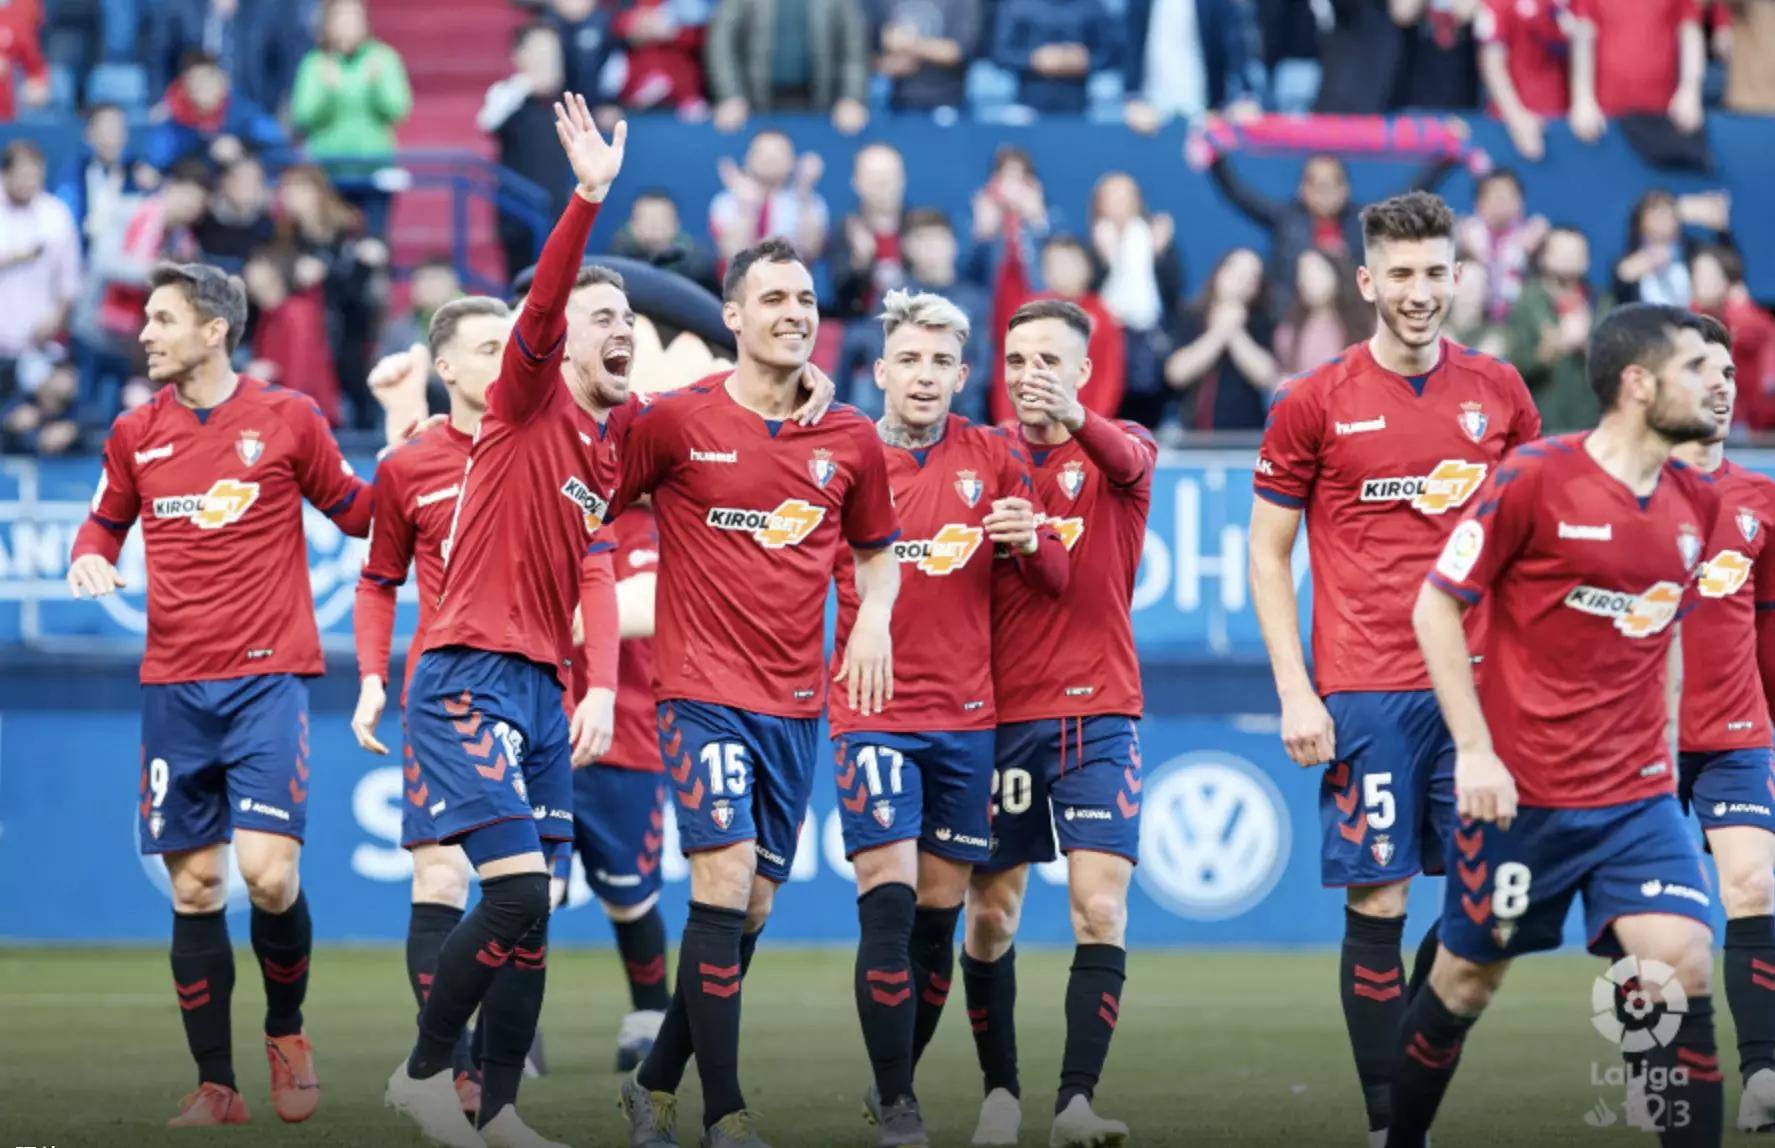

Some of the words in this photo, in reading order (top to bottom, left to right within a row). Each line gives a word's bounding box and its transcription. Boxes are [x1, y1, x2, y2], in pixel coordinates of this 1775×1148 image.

[150, 757, 169, 808] 9
[700, 742, 747, 796] 15
[856, 747, 904, 796] 17
[1363, 772, 1396, 830] 5
[1492, 861, 1532, 920] 8
